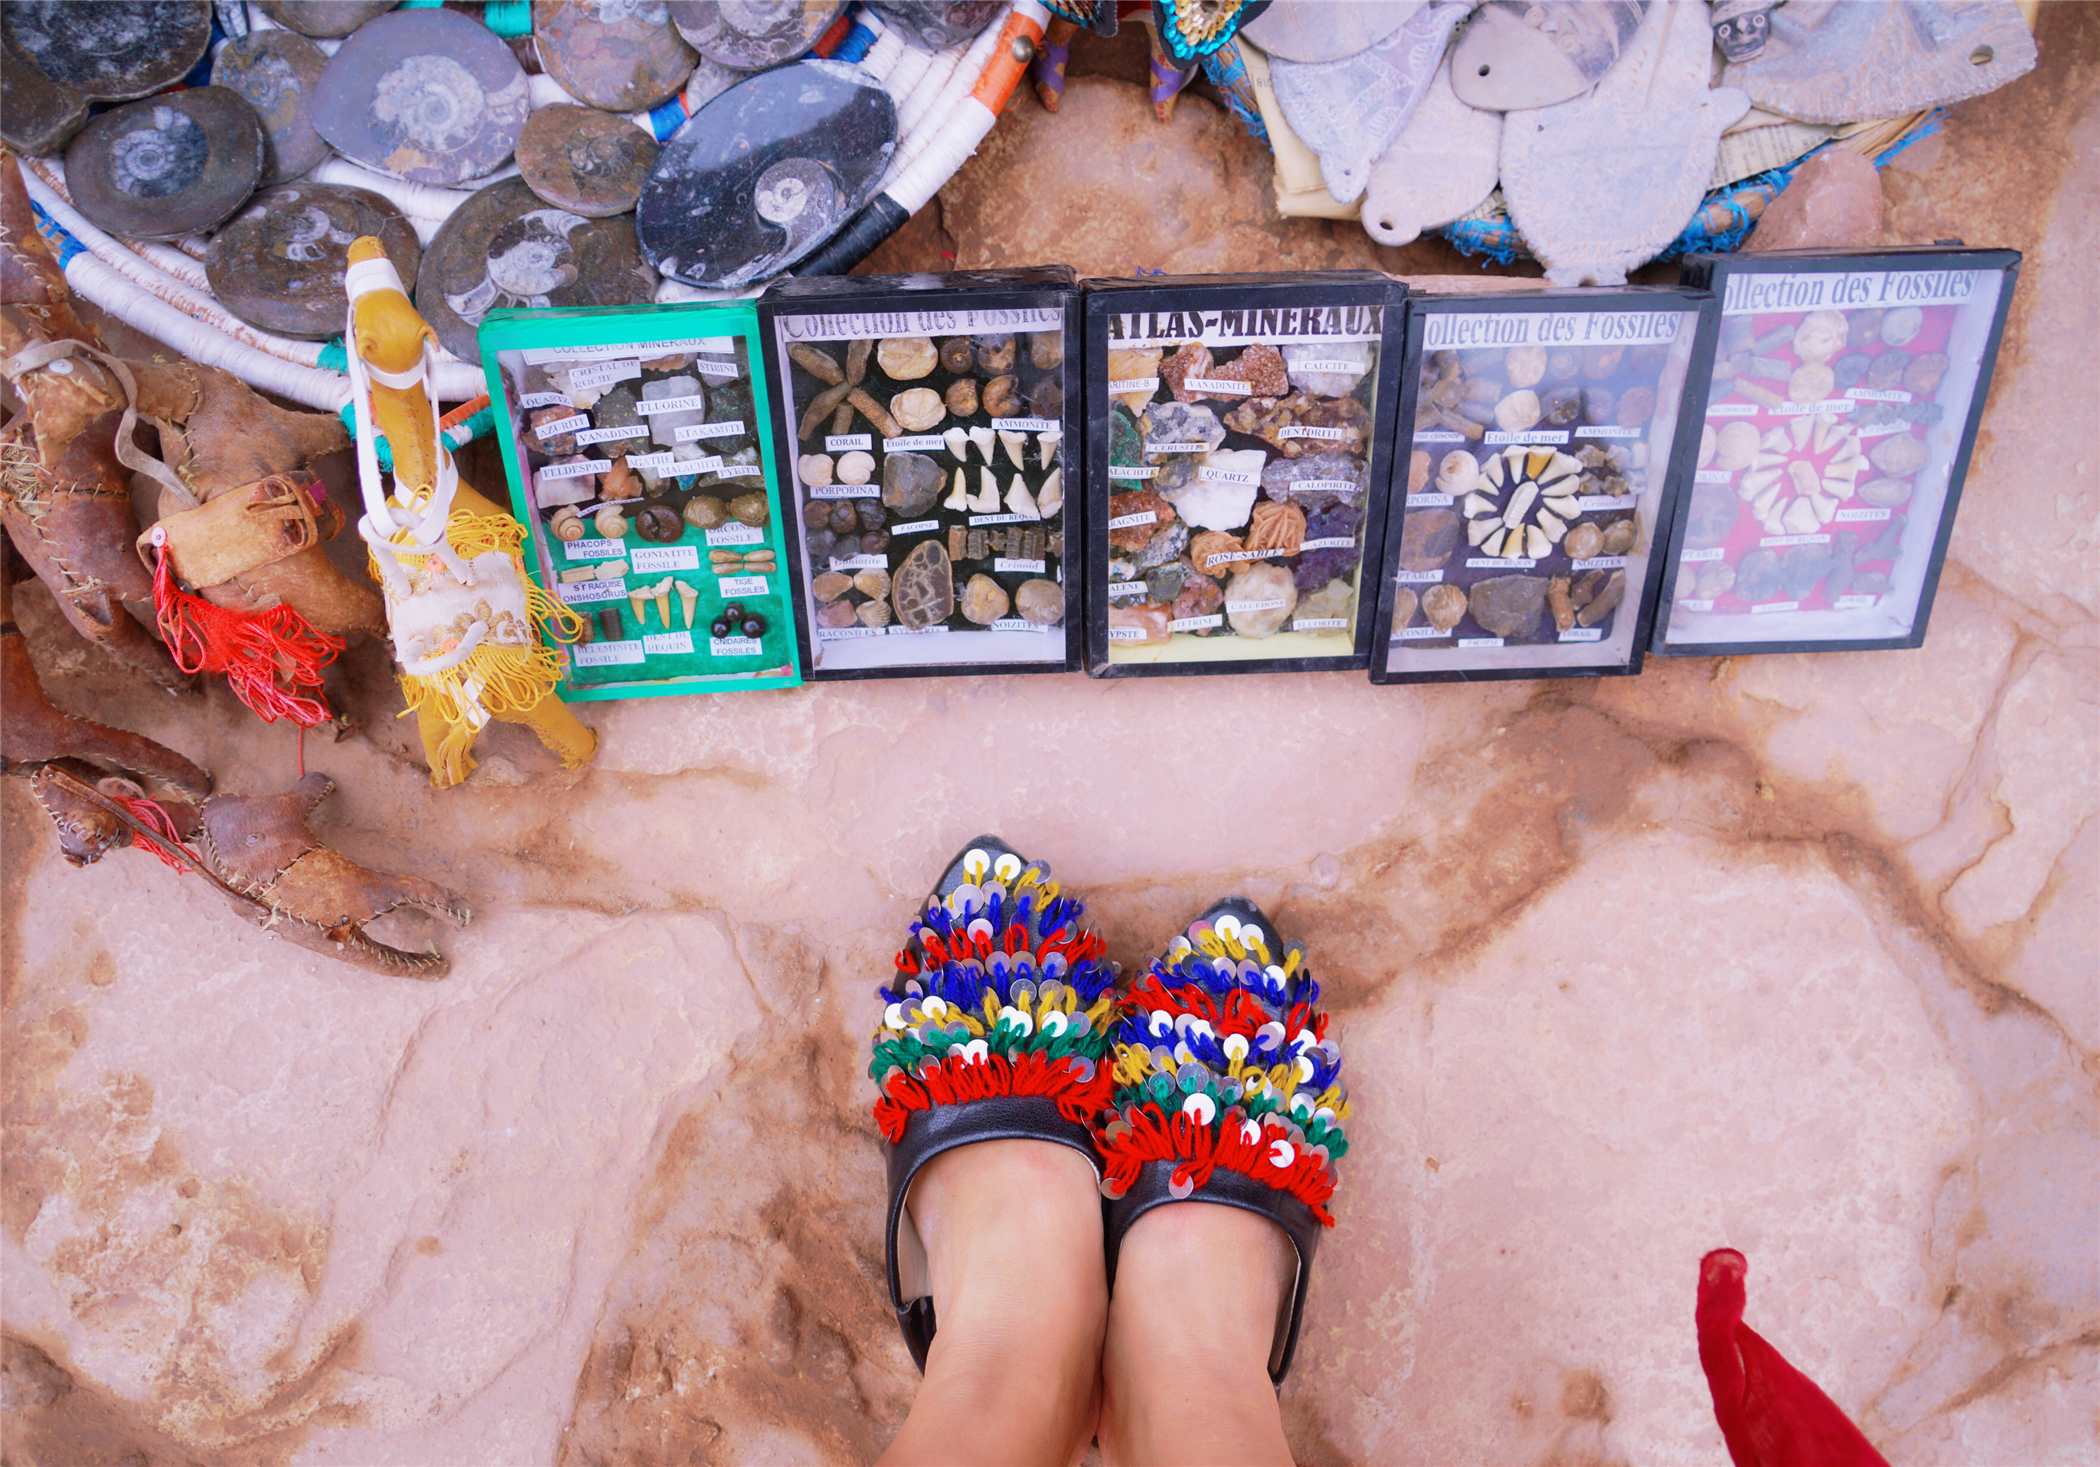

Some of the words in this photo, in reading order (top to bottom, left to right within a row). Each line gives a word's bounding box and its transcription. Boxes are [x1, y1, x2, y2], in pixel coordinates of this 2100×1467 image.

[1832, 272, 1873, 304] des
[1877, 271, 1974, 302] Fossiles
[1109, 306, 1383, 340] ATLAS-MINERAUX
[1427, 313, 1530, 346] ollection
[1537, 312, 1577, 342] des
[1582, 311, 1679, 340] Fossiles
[638, 338, 707, 350] MINERAUX
[571, 361, 620, 378] CRISTAL
[622, 360, 638, 368] DE
[699, 363, 737, 374] STIBINE
[1305, 361, 1351, 371] CALCITE
[574, 374, 614, 389] ROCHE
[1189, 380, 1250, 391] VANADINITE
[526, 395, 572, 407] QUARTZ
[640, 398, 698, 412] FLUORINE
[1809, 400, 1823, 413] de
[1826, 402, 1851, 412] mer
[540, 417, 586, 438] AZURITE
[676, 423, 744, 439] ATAKAMITE
[579, 426, 647, 443] VANADINITE
[1486, 432, 1522, 444] Etoile
[1523, 432, 1536, 443] de
[1538, 434, 1564, 443] mer
[830, 438, 864, 447] CORAIL
[886, 438, 912, 448] Etoile
[914, 437, 924, 447] de
[927, 439, 944, 447] mer
[629, 454, 673, 467] AGATHE
[543, 461, 612, 478] FELDESPATE
[661, 460, 724, 476] MALACHITE
[720, 466, 760, 477] PYRITE
[1206, 470, 1249, 483] QUARTZ
[815, 486, 875, 496] PORPORINA
[1298, 481, 1356, 490] CALOPIRITE
[974, 516, 994, 524] DENT
[567, 540, 613, 550] PHACOPS
[710, 534, 754, 545] FOSSILE
[1312, 539, 1353, 548] AZURITE
[583, 549, 623, 558] FOSSILES
[634, 549, 695, 560] GONIATITE
[636, 561, 681, 570] FOSSILE
[1000, 560, 1039, 570] Crinoid
[588, 580, 622, 591] RAGUISE
[733, 578, 753, 586] TIGE
[1110, 583, 1140, 592] ALENE
[725, 586, 765, 595] FOSSILES
[1231, 600, 1285, 610] CALCEDONE
[1298, 620, 1342, 629] FLUORITE
[645, 632, 672, 642] DENT
[674, 631, 690, 639] DE
[1109, 630, 1140, 639] YPSTE
[648, 641, 687, 652] REQUIN
[713, 637, 758, 646] CNIDAIRES
[578, 642, 641, 654] BELEMINITE
[716, 647, 757, 655] FOSSILES
[580, 655, 620, 665] FOSSILE
